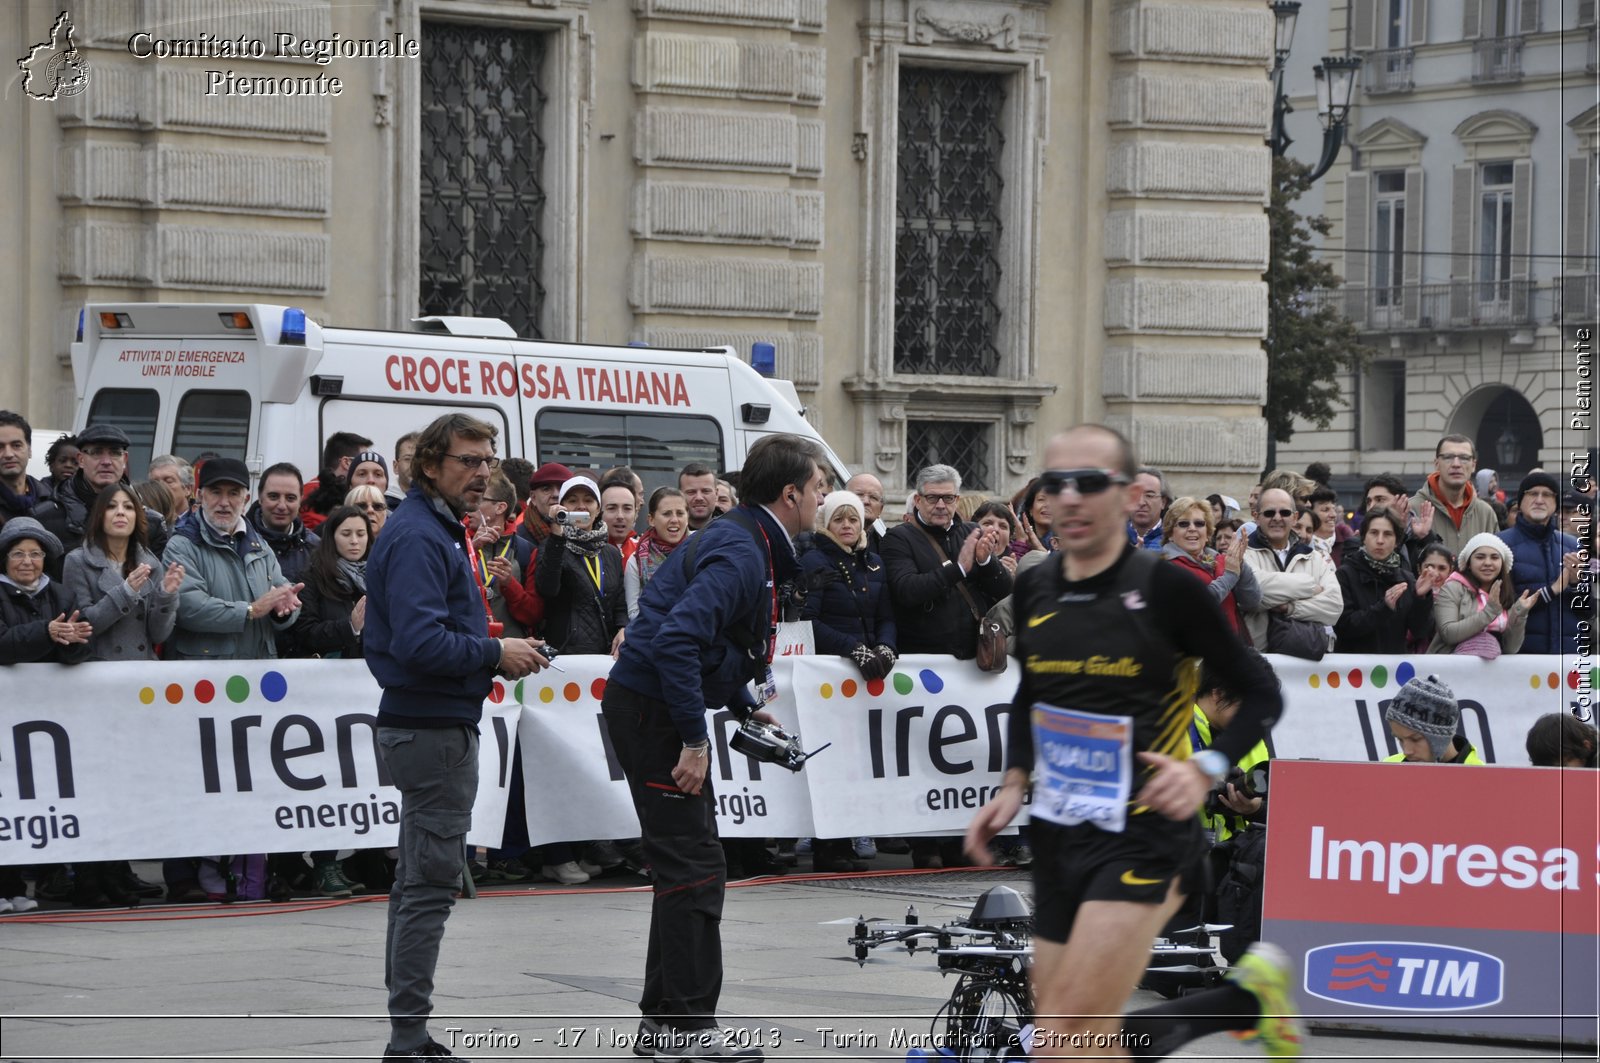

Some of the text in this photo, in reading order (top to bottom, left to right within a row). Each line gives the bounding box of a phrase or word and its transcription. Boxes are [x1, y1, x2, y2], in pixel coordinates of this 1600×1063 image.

[164, 351, 176, 361] DI
[178, 350, 245, 363] EMERGENZA
[174, 364, 216, 377] MOBILE
[385, 355, 691, 407] CROCE ROSSA ITALIANA
[198, 713, 396, 794] iren
[275, 793, 401, 835] energia
[1309, 826, 1580, 894] Impresa
[1397, 957, 1480, 998] TIM
